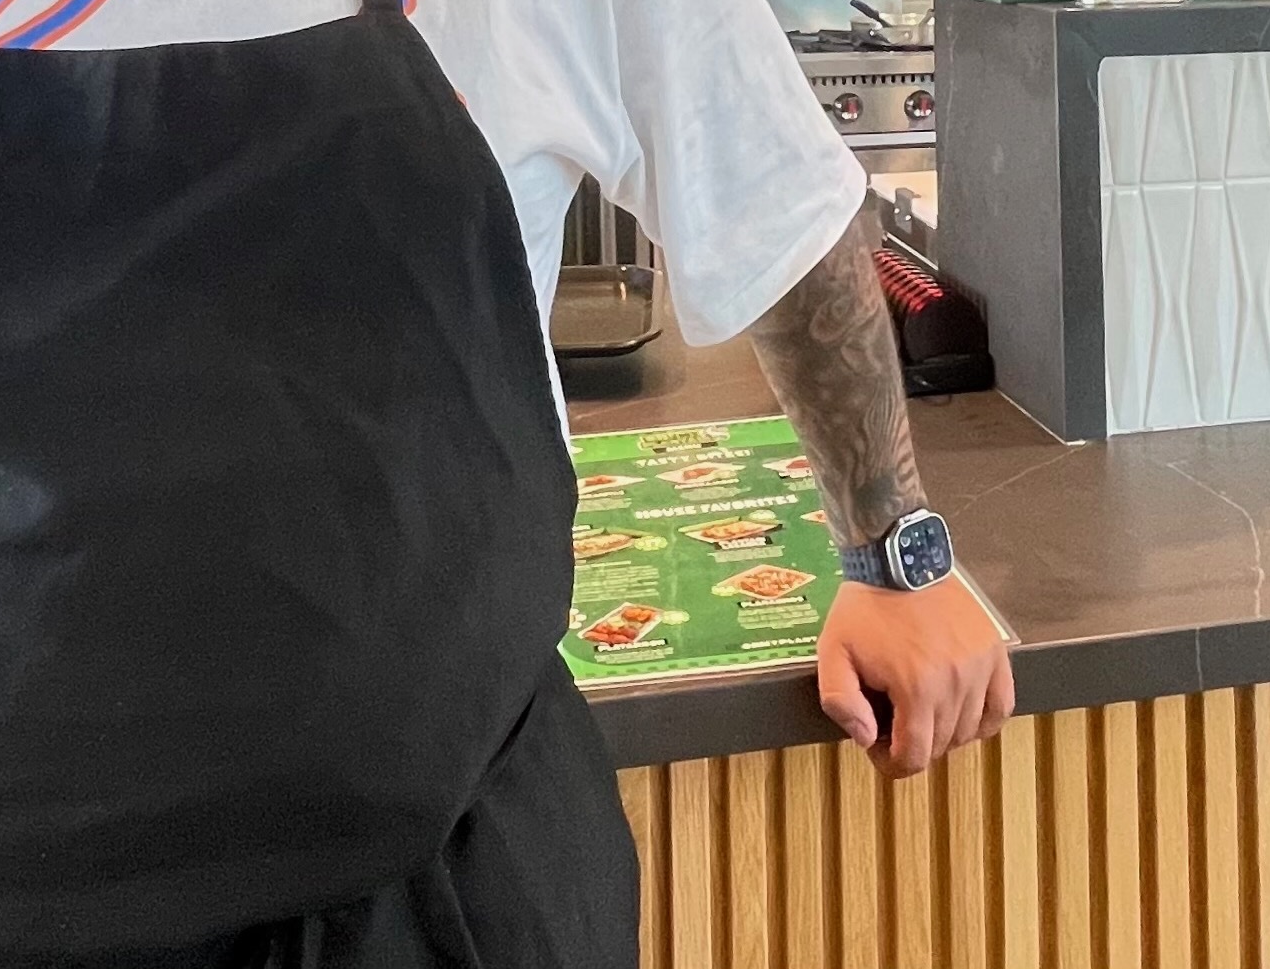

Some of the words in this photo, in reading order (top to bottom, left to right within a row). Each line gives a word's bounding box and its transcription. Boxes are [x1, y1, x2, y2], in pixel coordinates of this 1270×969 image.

[635, 454, 691, 468] TASTY
[634, 504, 697, 520] HOUSE
[700, 494, 799, 514] FAVORITES
